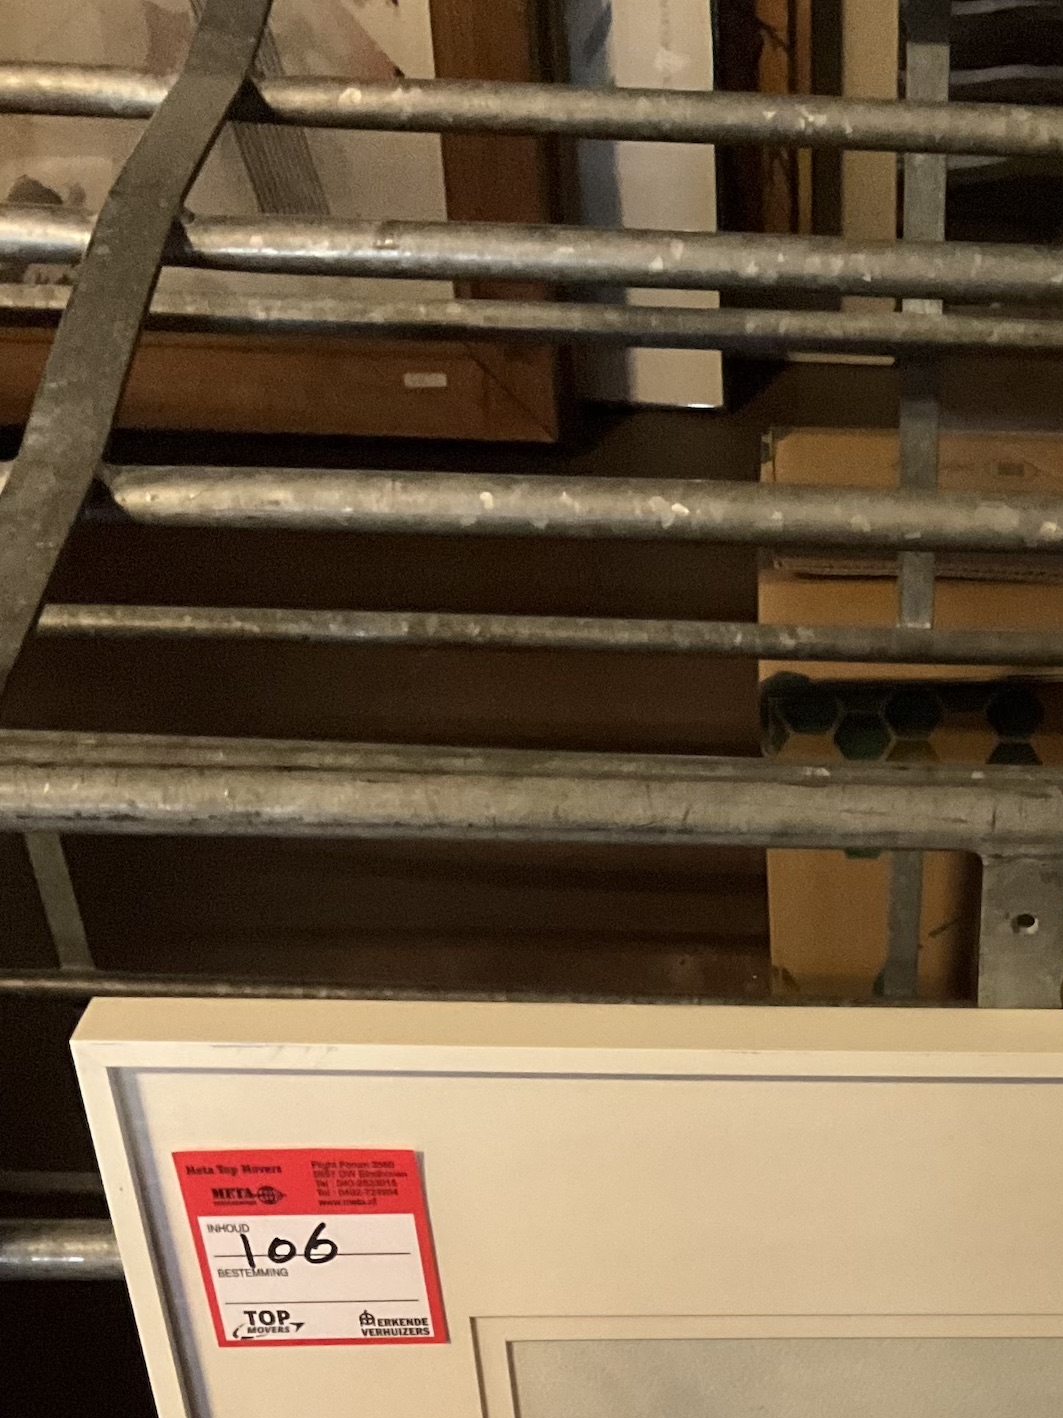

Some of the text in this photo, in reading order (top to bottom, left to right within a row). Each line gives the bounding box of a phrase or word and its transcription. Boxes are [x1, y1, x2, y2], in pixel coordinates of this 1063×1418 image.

[185, 1165, 282, 1177] Meta Top Movers
[211, 1188, 255, 1199] META
[206, 1223, 250, 1233] INHOUD
[240, 1222, 338, 1269] 106
[217, 1268, 289, 1278] BESTEMMING
[243, 1310, 291, 1326] TOP
[377, 1317, 429, 1327] ERKENDE
[247, 1326, 290, 1334] MOVERS
[361, 1327, 431, 1337] VERHUIZERS
